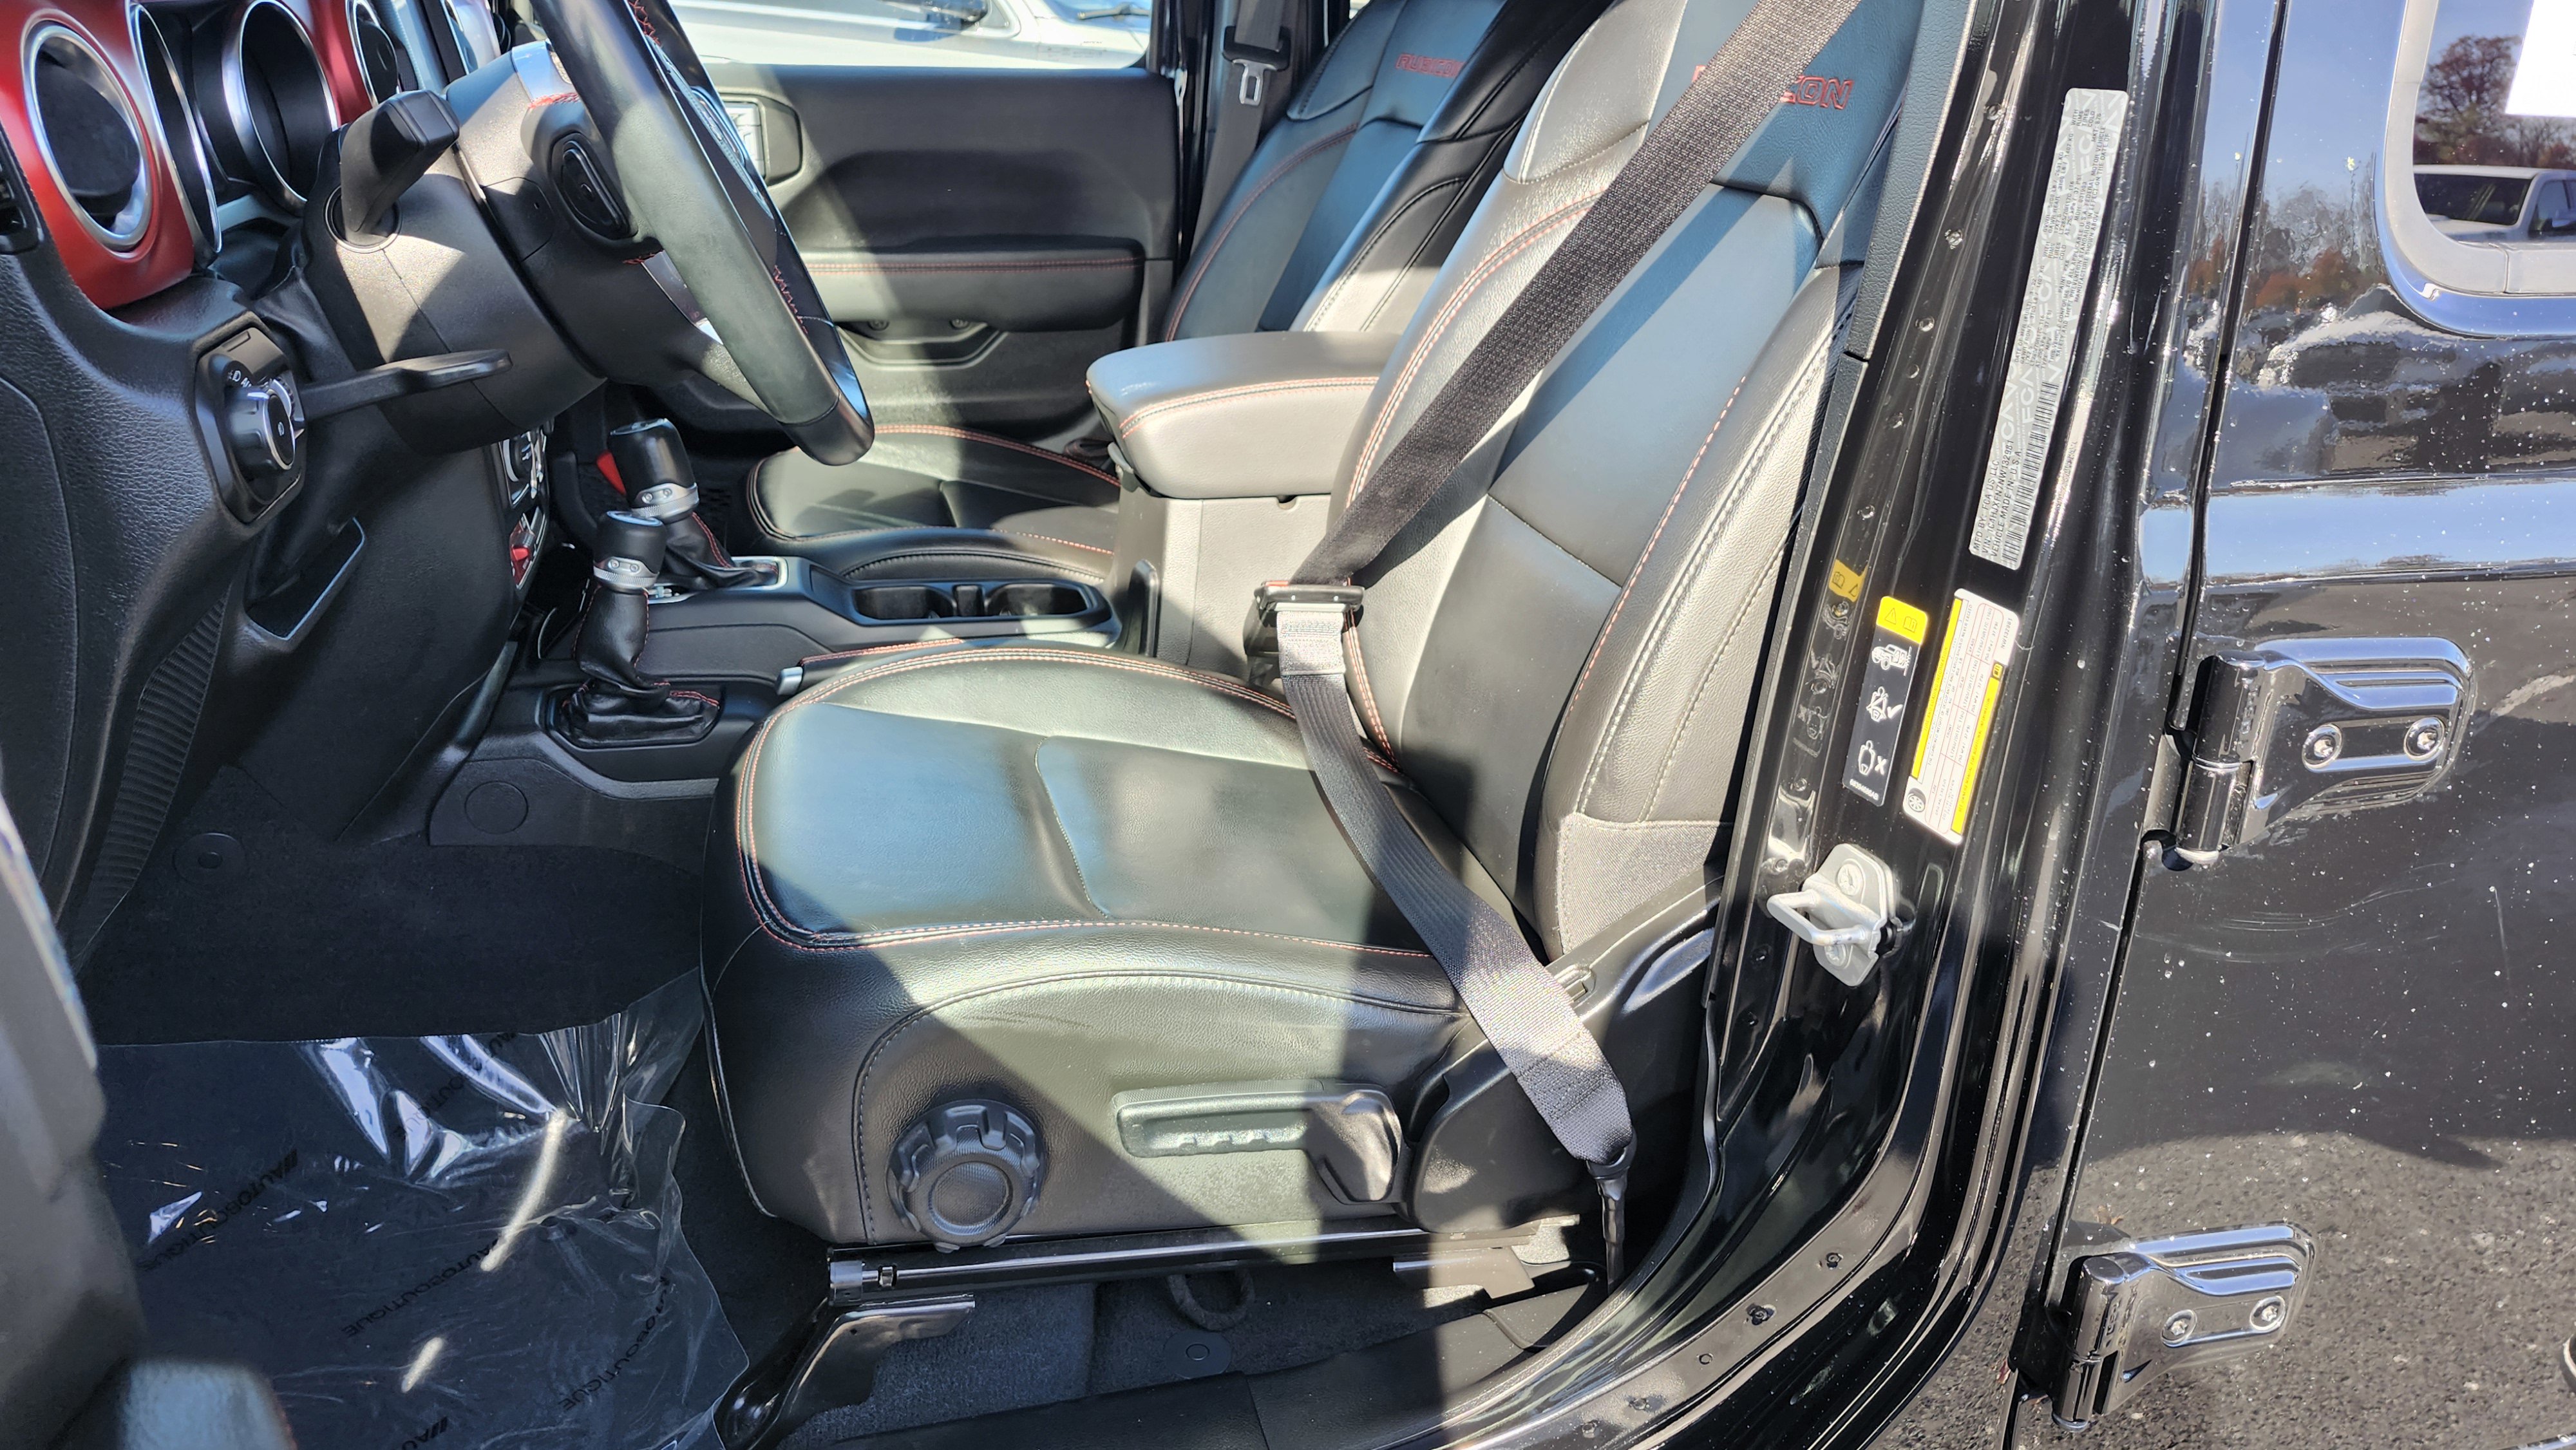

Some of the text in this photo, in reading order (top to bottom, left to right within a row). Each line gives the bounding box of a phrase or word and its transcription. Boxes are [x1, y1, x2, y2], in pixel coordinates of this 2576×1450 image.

[1989, 460, 1999, 476] LLC
[1986, 478, 1995, 491] US
[1982, 493, 1992, 510] FCA
[1991, 519, 2005, 558] VEHICLE
[2000, 492, 2012, 520] MADE
[1973, 531, 1983, 551] MFD
